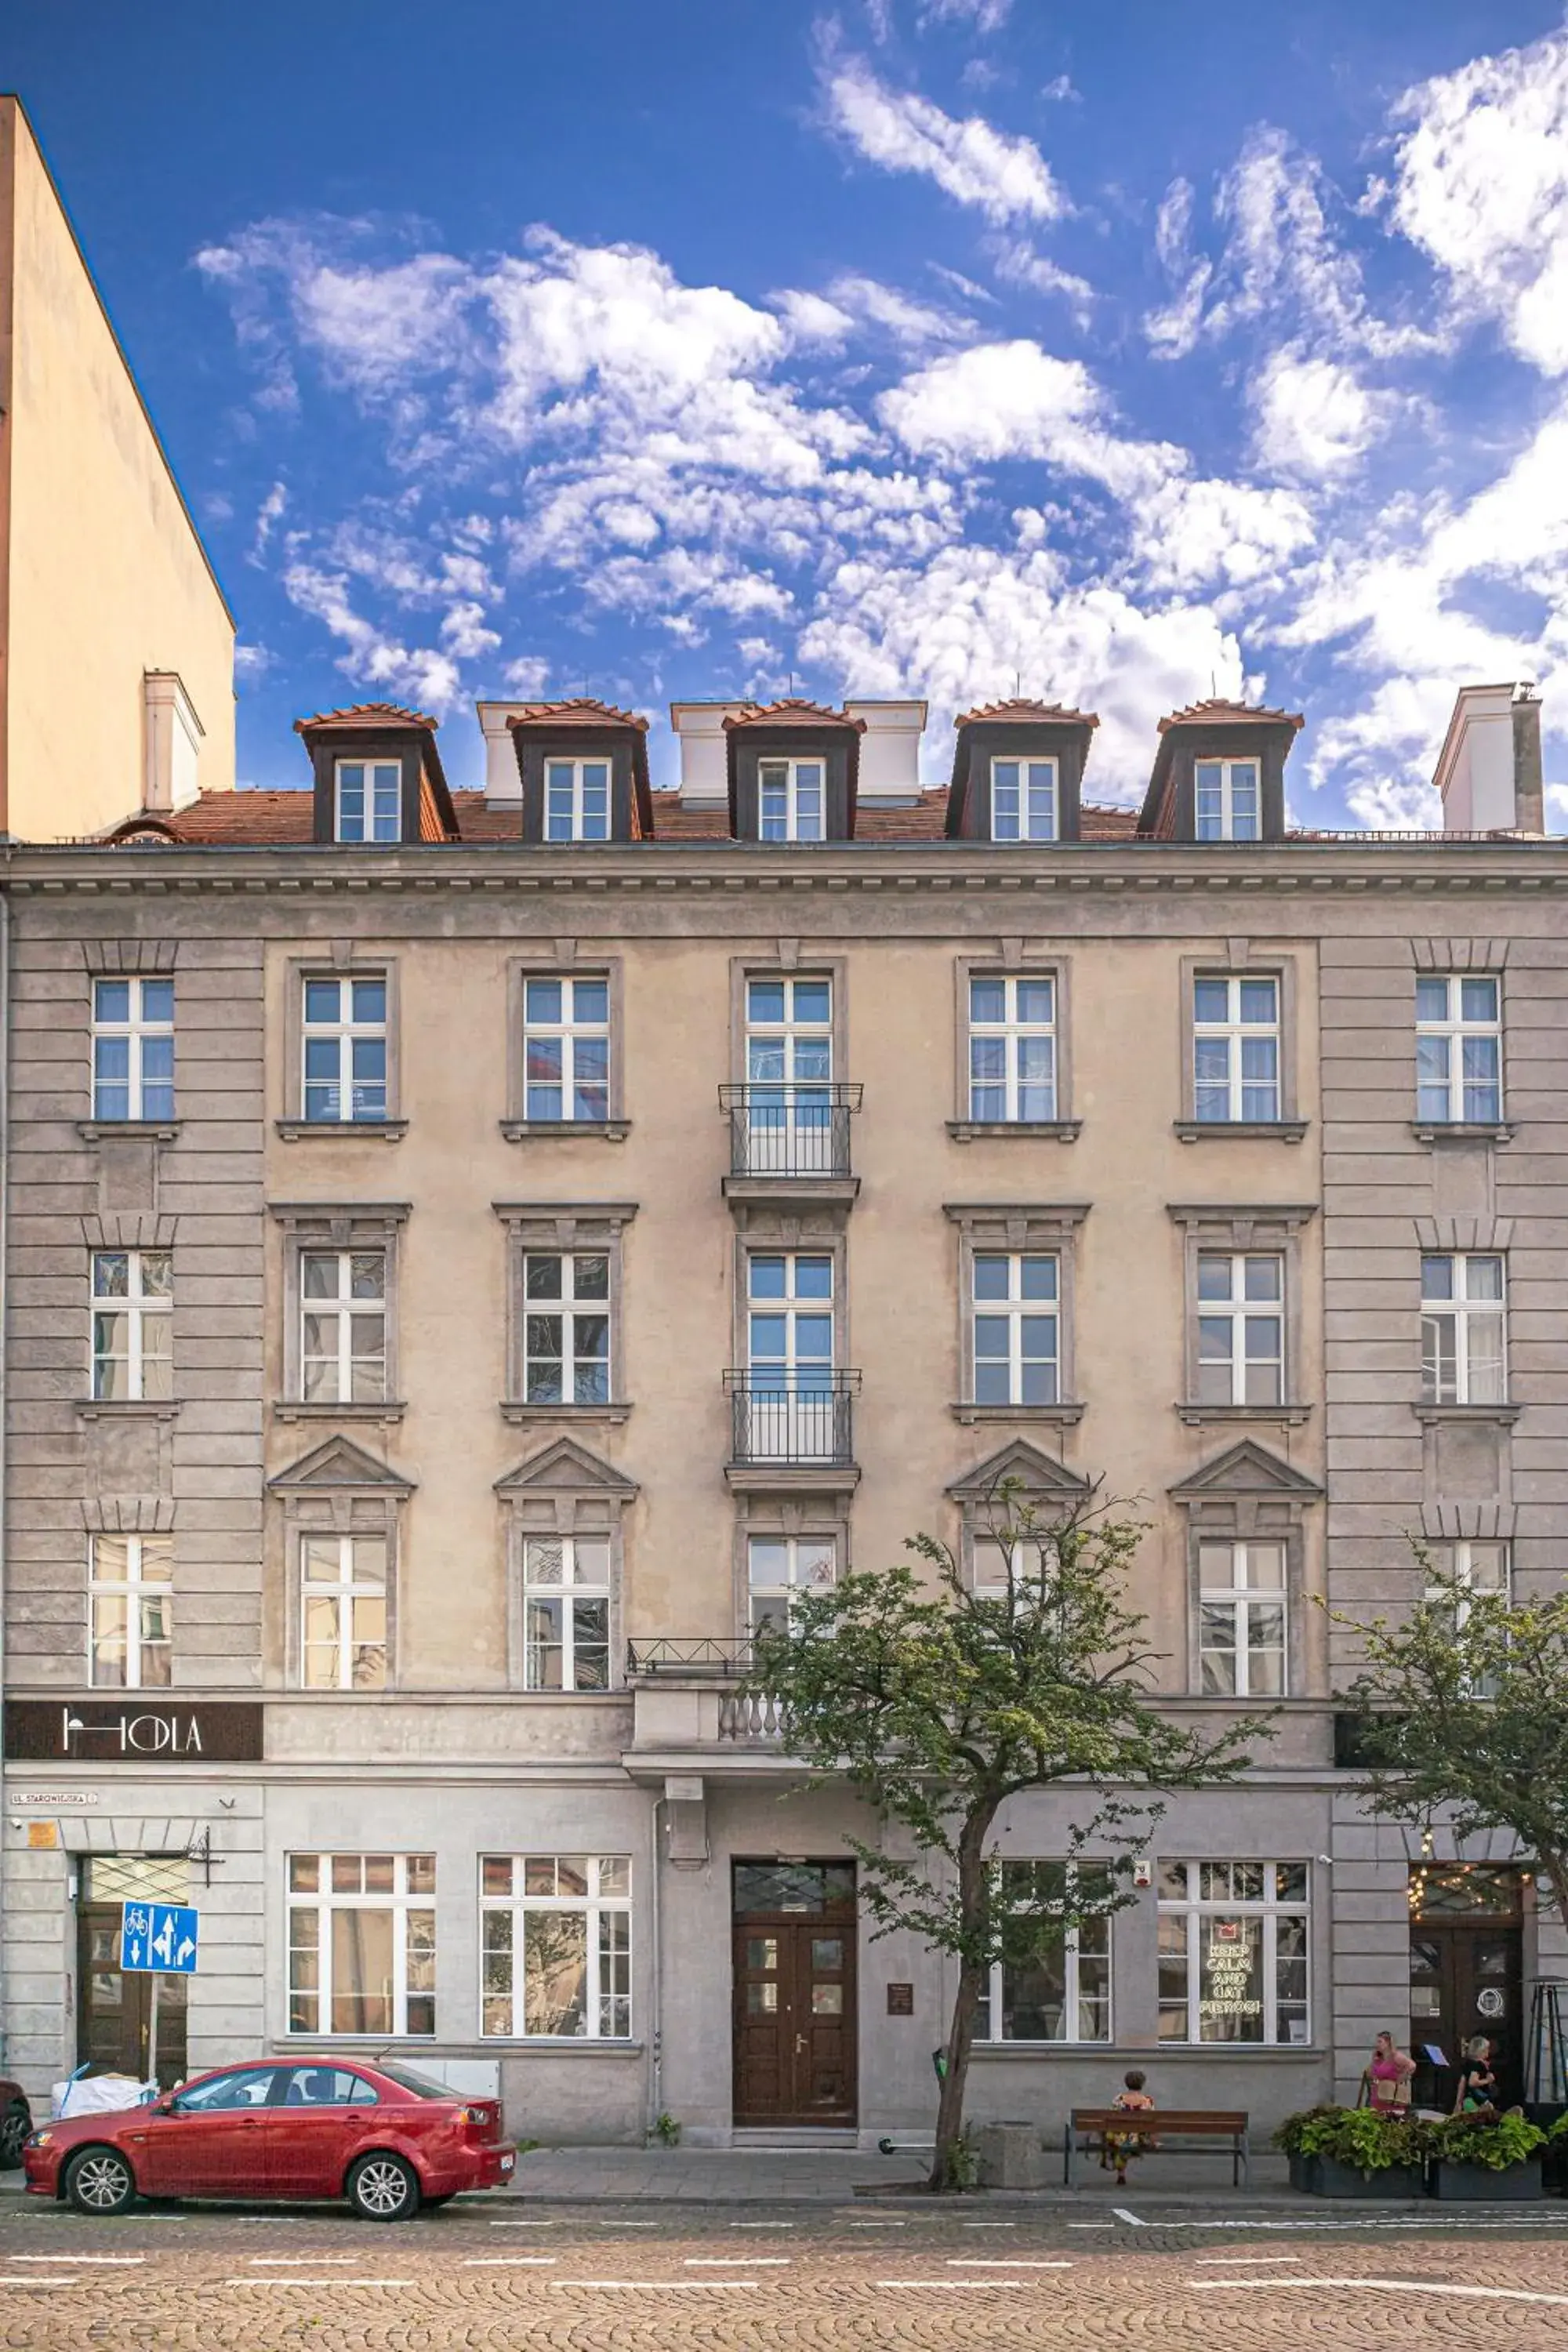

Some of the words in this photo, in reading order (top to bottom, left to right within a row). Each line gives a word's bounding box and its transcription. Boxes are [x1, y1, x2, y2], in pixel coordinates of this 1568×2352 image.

[1210, 1944, 1249, 1958] KEEP
[1207, 1958, 1253, 1972] CALM
[1212, 1972, 1247, 1985] AND
[1199, 2000, 1260, 2014] PIEROGI
